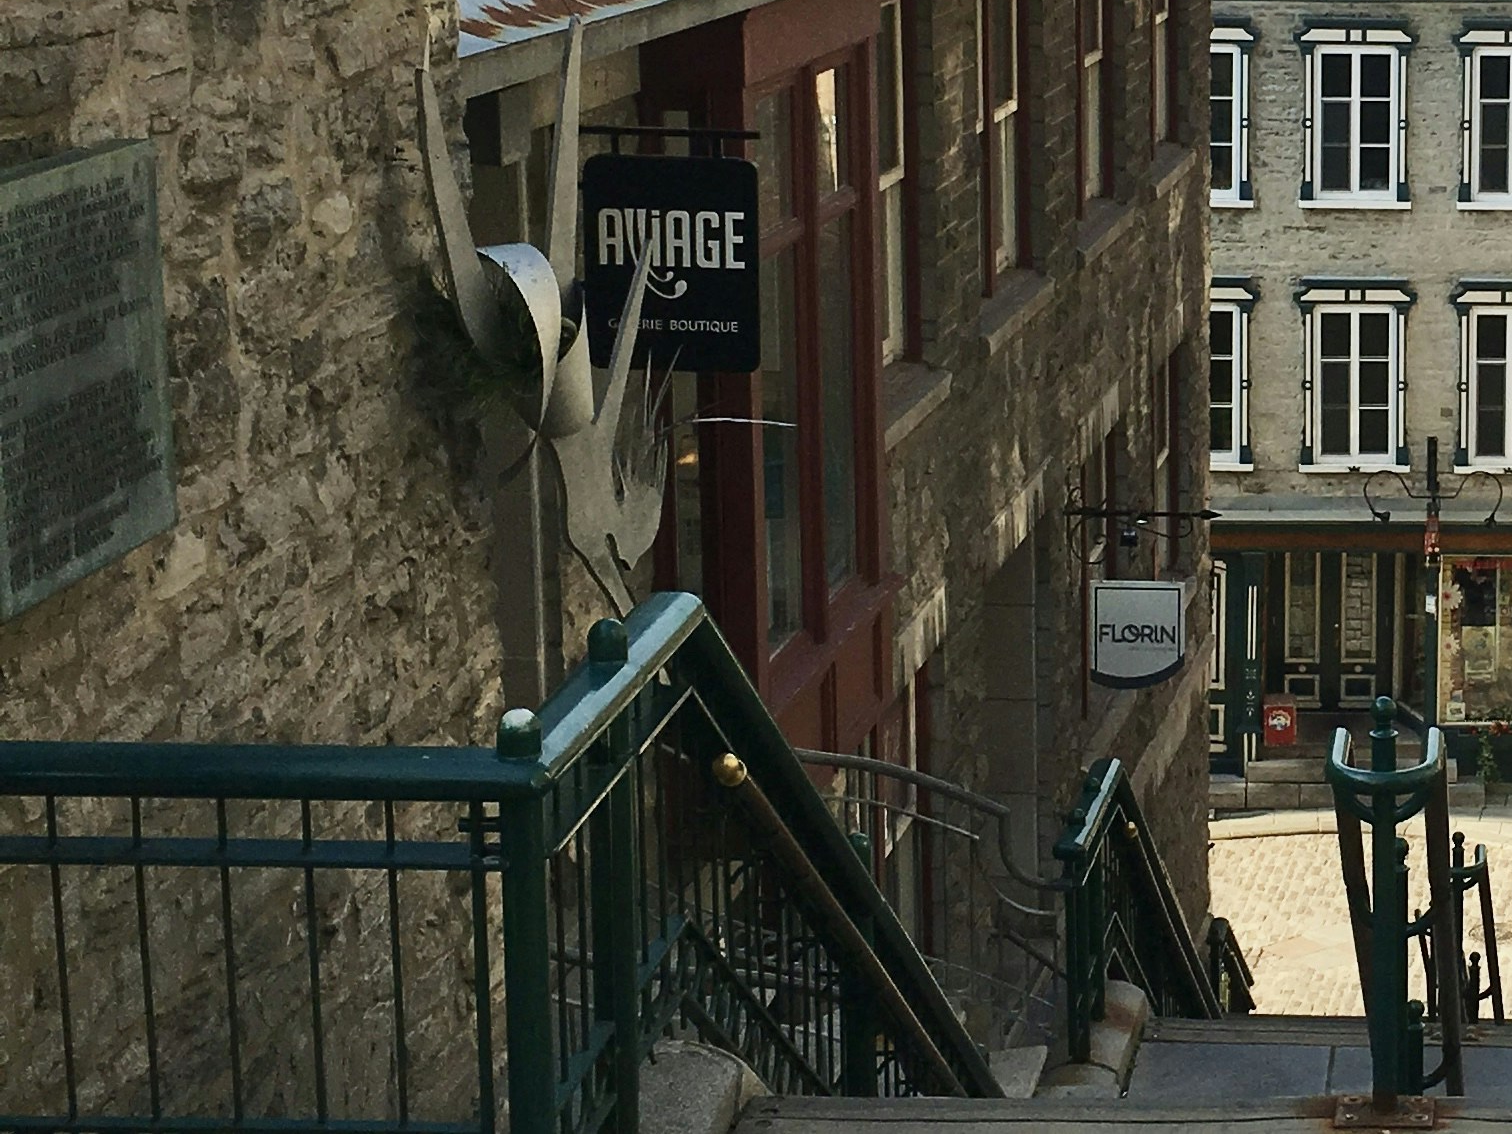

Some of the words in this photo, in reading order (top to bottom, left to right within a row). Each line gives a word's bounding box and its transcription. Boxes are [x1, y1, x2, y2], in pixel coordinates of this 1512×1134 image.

[607, 317, 663, 330] GERIE
[669, 319, 739, 333] BOUTIQUE
[1099, 623, 1177, 645] FLORIN
